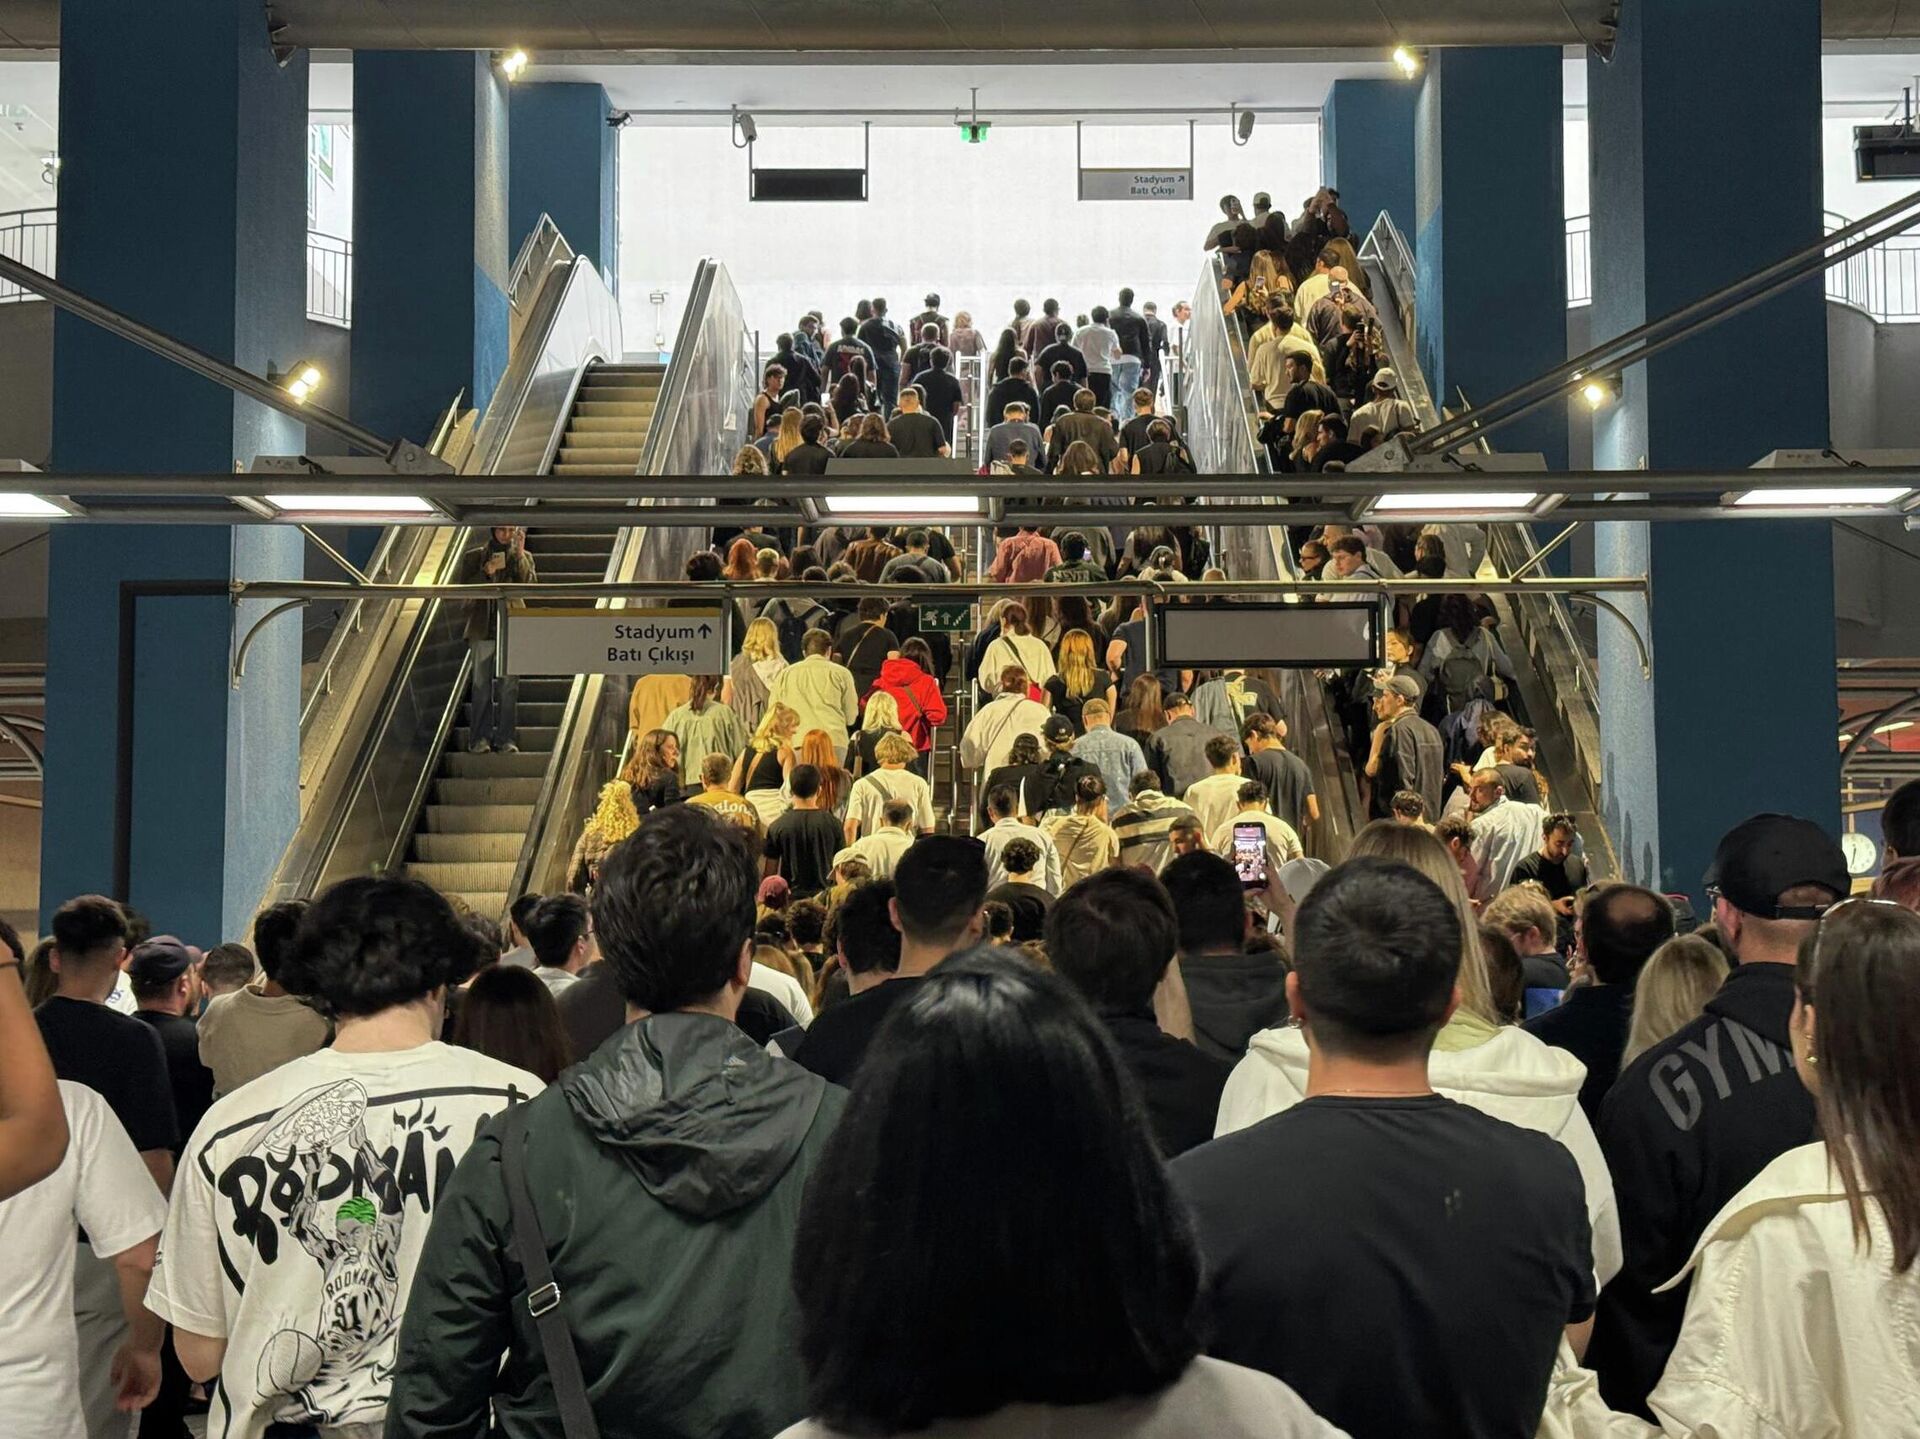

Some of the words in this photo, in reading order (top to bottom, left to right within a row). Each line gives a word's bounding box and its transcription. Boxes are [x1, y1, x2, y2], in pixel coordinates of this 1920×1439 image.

[1133, 175, 1175, 185] Stadyum
[615, 624, 695, 642] Stadyum
[607, 647, 642, 661] Batı
[648, 646, 695, 665] Çıkışı
